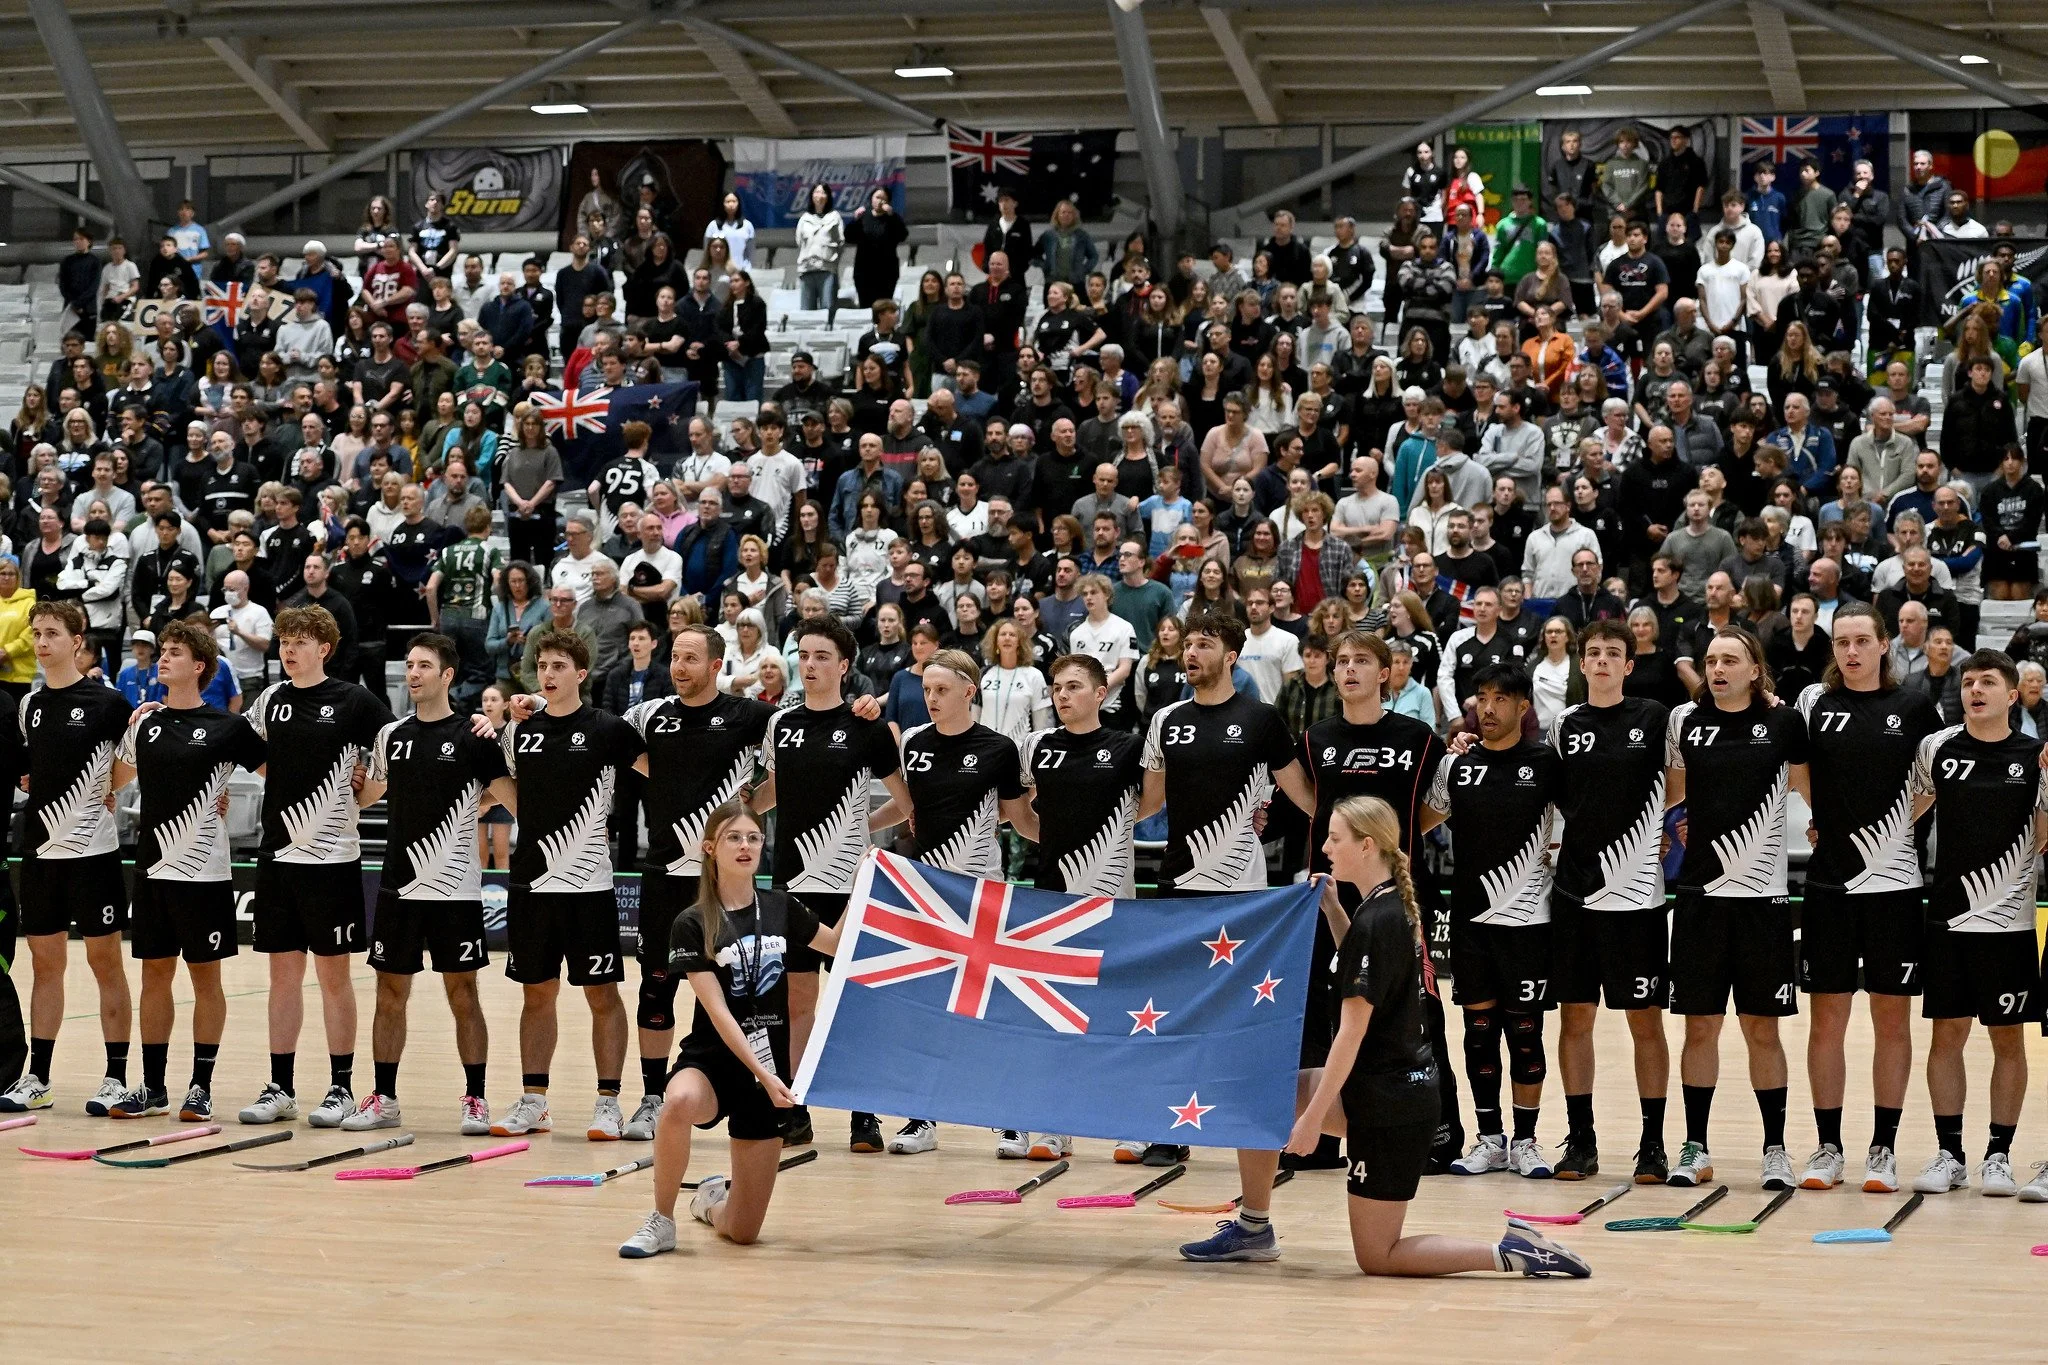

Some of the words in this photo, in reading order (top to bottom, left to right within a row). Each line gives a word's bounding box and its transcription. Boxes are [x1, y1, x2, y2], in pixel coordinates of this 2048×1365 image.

[605, 467, 642, 496] 95
[391, 534, 407, 545] 20
[454, 551, 476, 571] 14
[1099, 642, 1114, 652] 27
[983, 680, 1001, 691] 23
[32, 709, 41, 727] 8
[271, 704, 292, 722] 10
[1820, 712, 1850, 732] 77
[654, 715, 681, 733] 23
[148, 726, 161, 743] 9
[518, 733, 545, 753] 22
[778, 728, 804, 747] 24
[1166, 725, 1196, 745] 33
[1567, 732, 1595, 754] 39
[1688, 726, 1720, 746] 47
[390, 740, 413, 760] 21
[1038, 749, 1067, 769] 27
[1379, 747, 1413, 771] 34
[906, 750, 934, 772] 25
[1942, 759, 1976, 781] 97
[1457, 766, 1488, 786] 37
[102, 906, 114, 925] 8
[209, 931, 222, 951] 9
[459, 938, 482, 962] 21
[732, 941, 780, 956] VLUTEER
[589, 953, 614, 975] 22
[1901, 962, 1918, 984] 7
[1519, 979, 1548, 1001] 37
[1775, 983, 1793, 1005] 4
[1999, 991, 2029, 1015] 97
